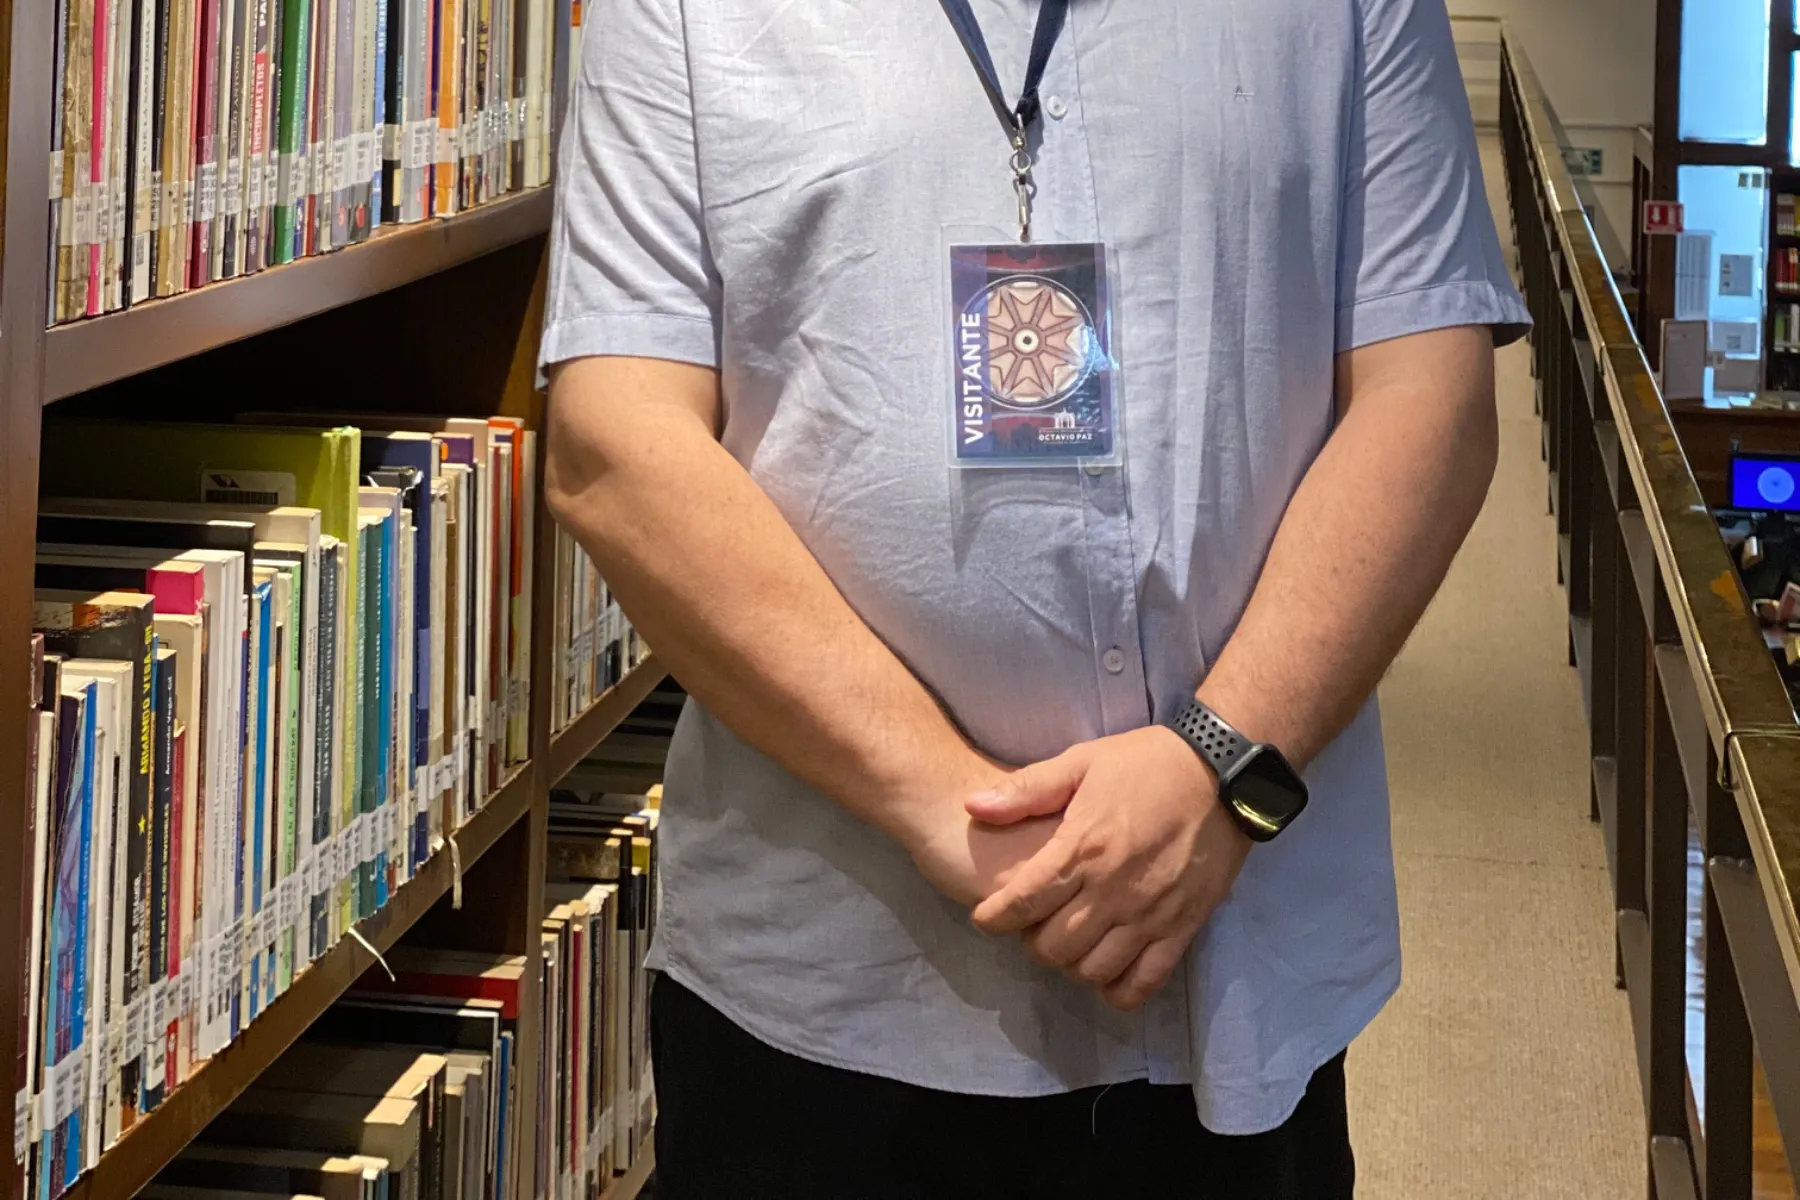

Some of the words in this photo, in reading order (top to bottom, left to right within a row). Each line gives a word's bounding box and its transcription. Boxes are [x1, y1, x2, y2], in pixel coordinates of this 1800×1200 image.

[254, 62, 265, 150] INCOMPLETOS
[961, 312, 984, 445] VISITANTE
[140, 697, 151, 775] ARMANDO
[165, 676, 173, 724] Vega-Gil
[164, 726, 172, 775] Armando
